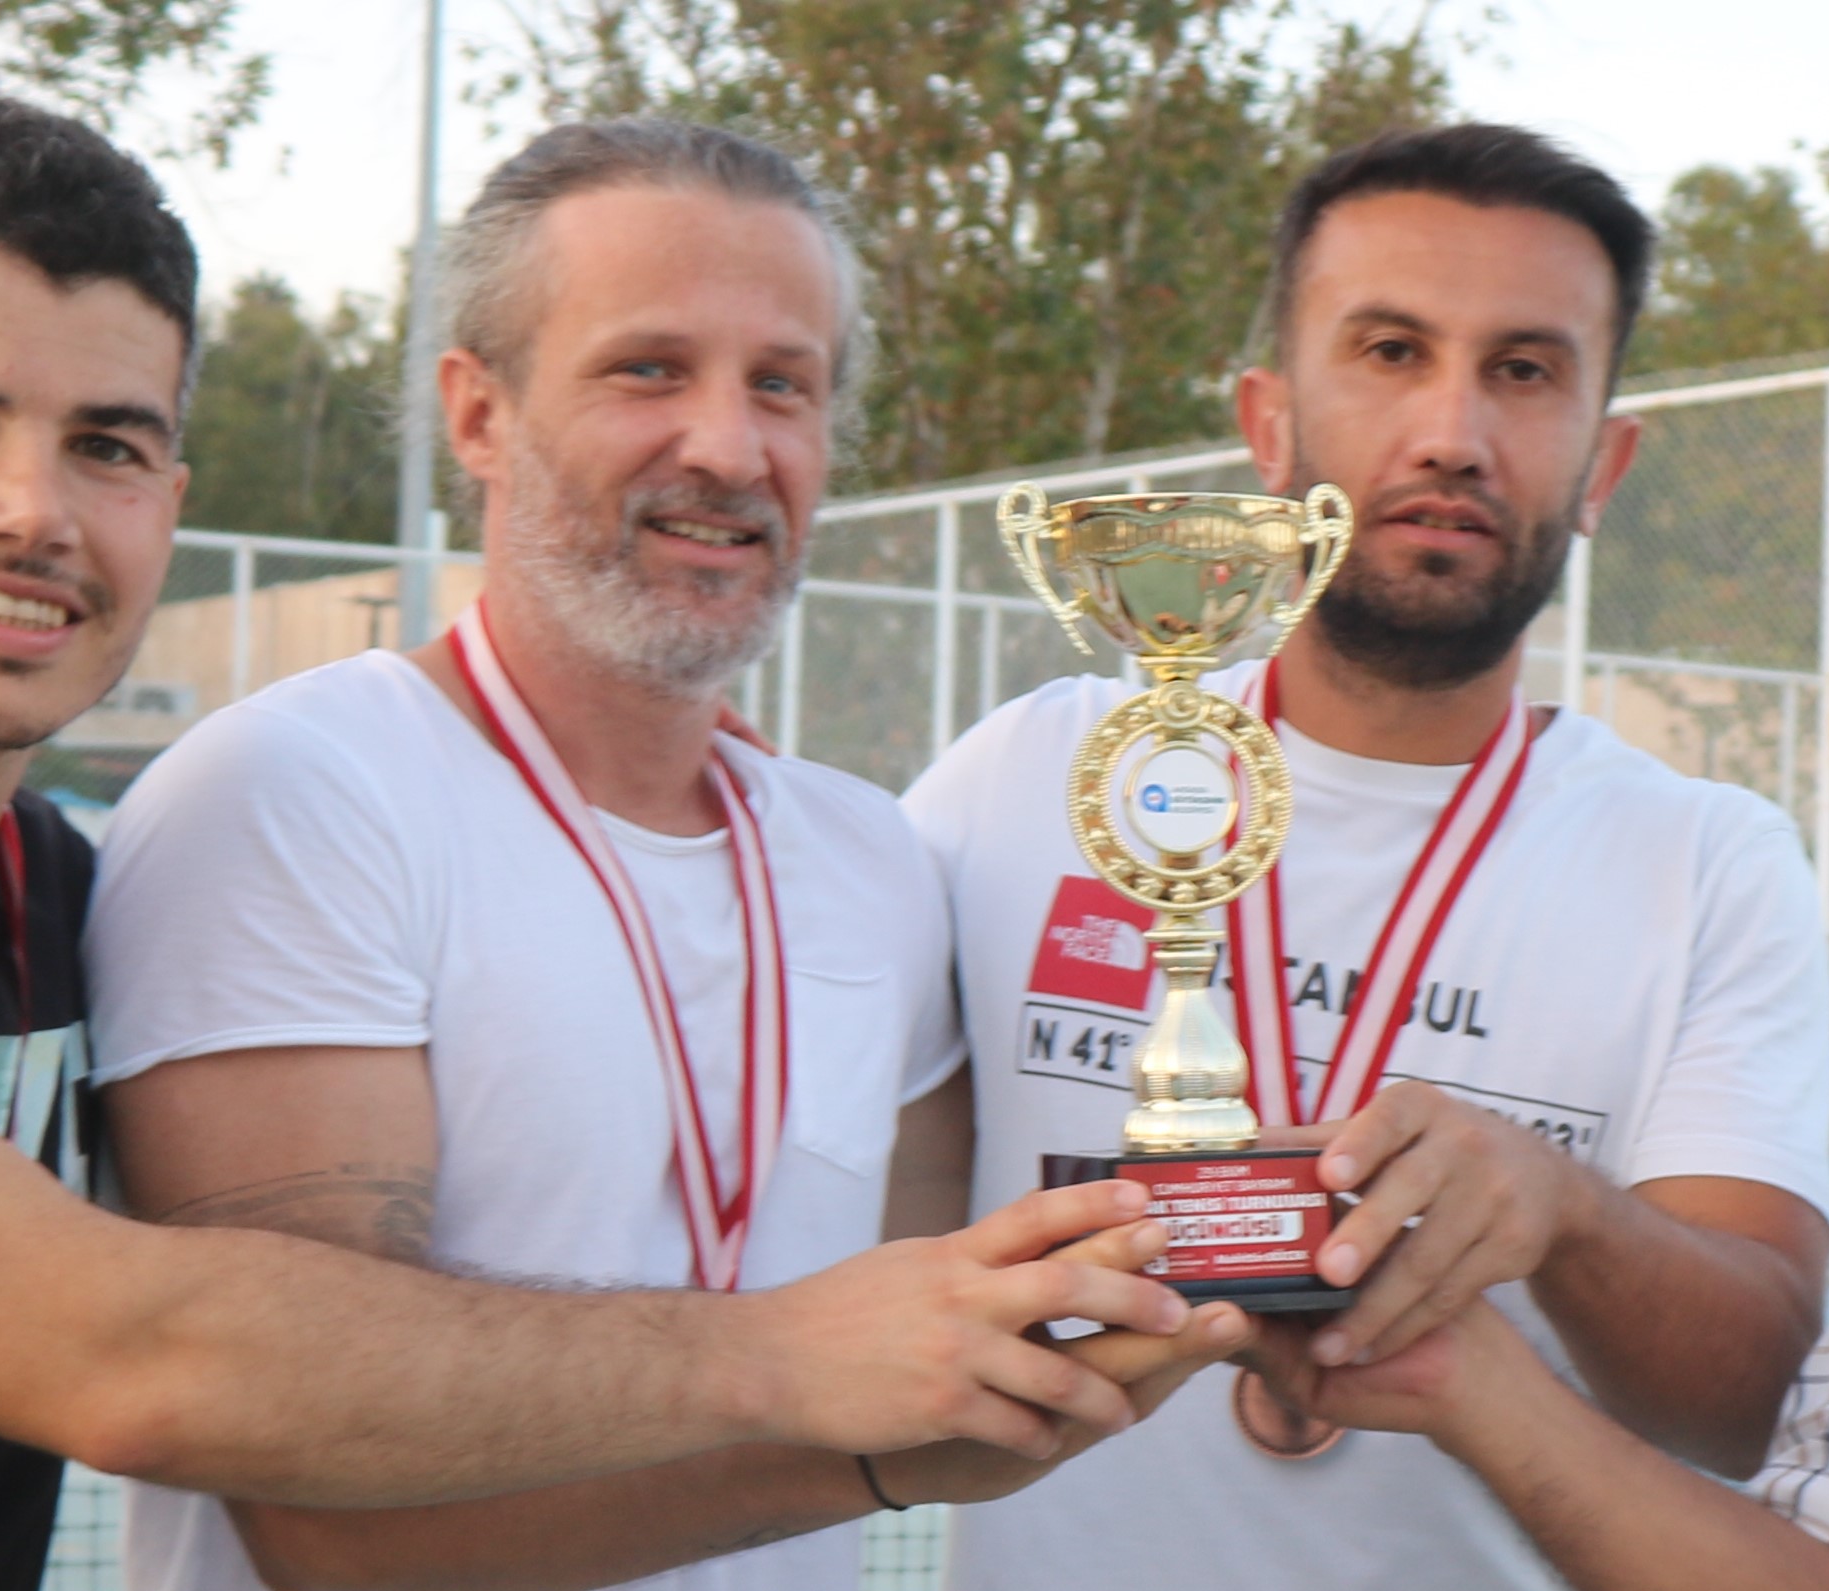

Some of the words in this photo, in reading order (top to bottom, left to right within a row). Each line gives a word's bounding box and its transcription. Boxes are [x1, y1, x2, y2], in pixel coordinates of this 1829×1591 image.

[1047, 923, 1116, 947] NORTH
[1081, 914, 1118, 934] THE
[1059, 940, 1113, 965] FACE
[1028, 1018, 1058, 1061] N
[1069, 1026, 1131, 1071] 41°
